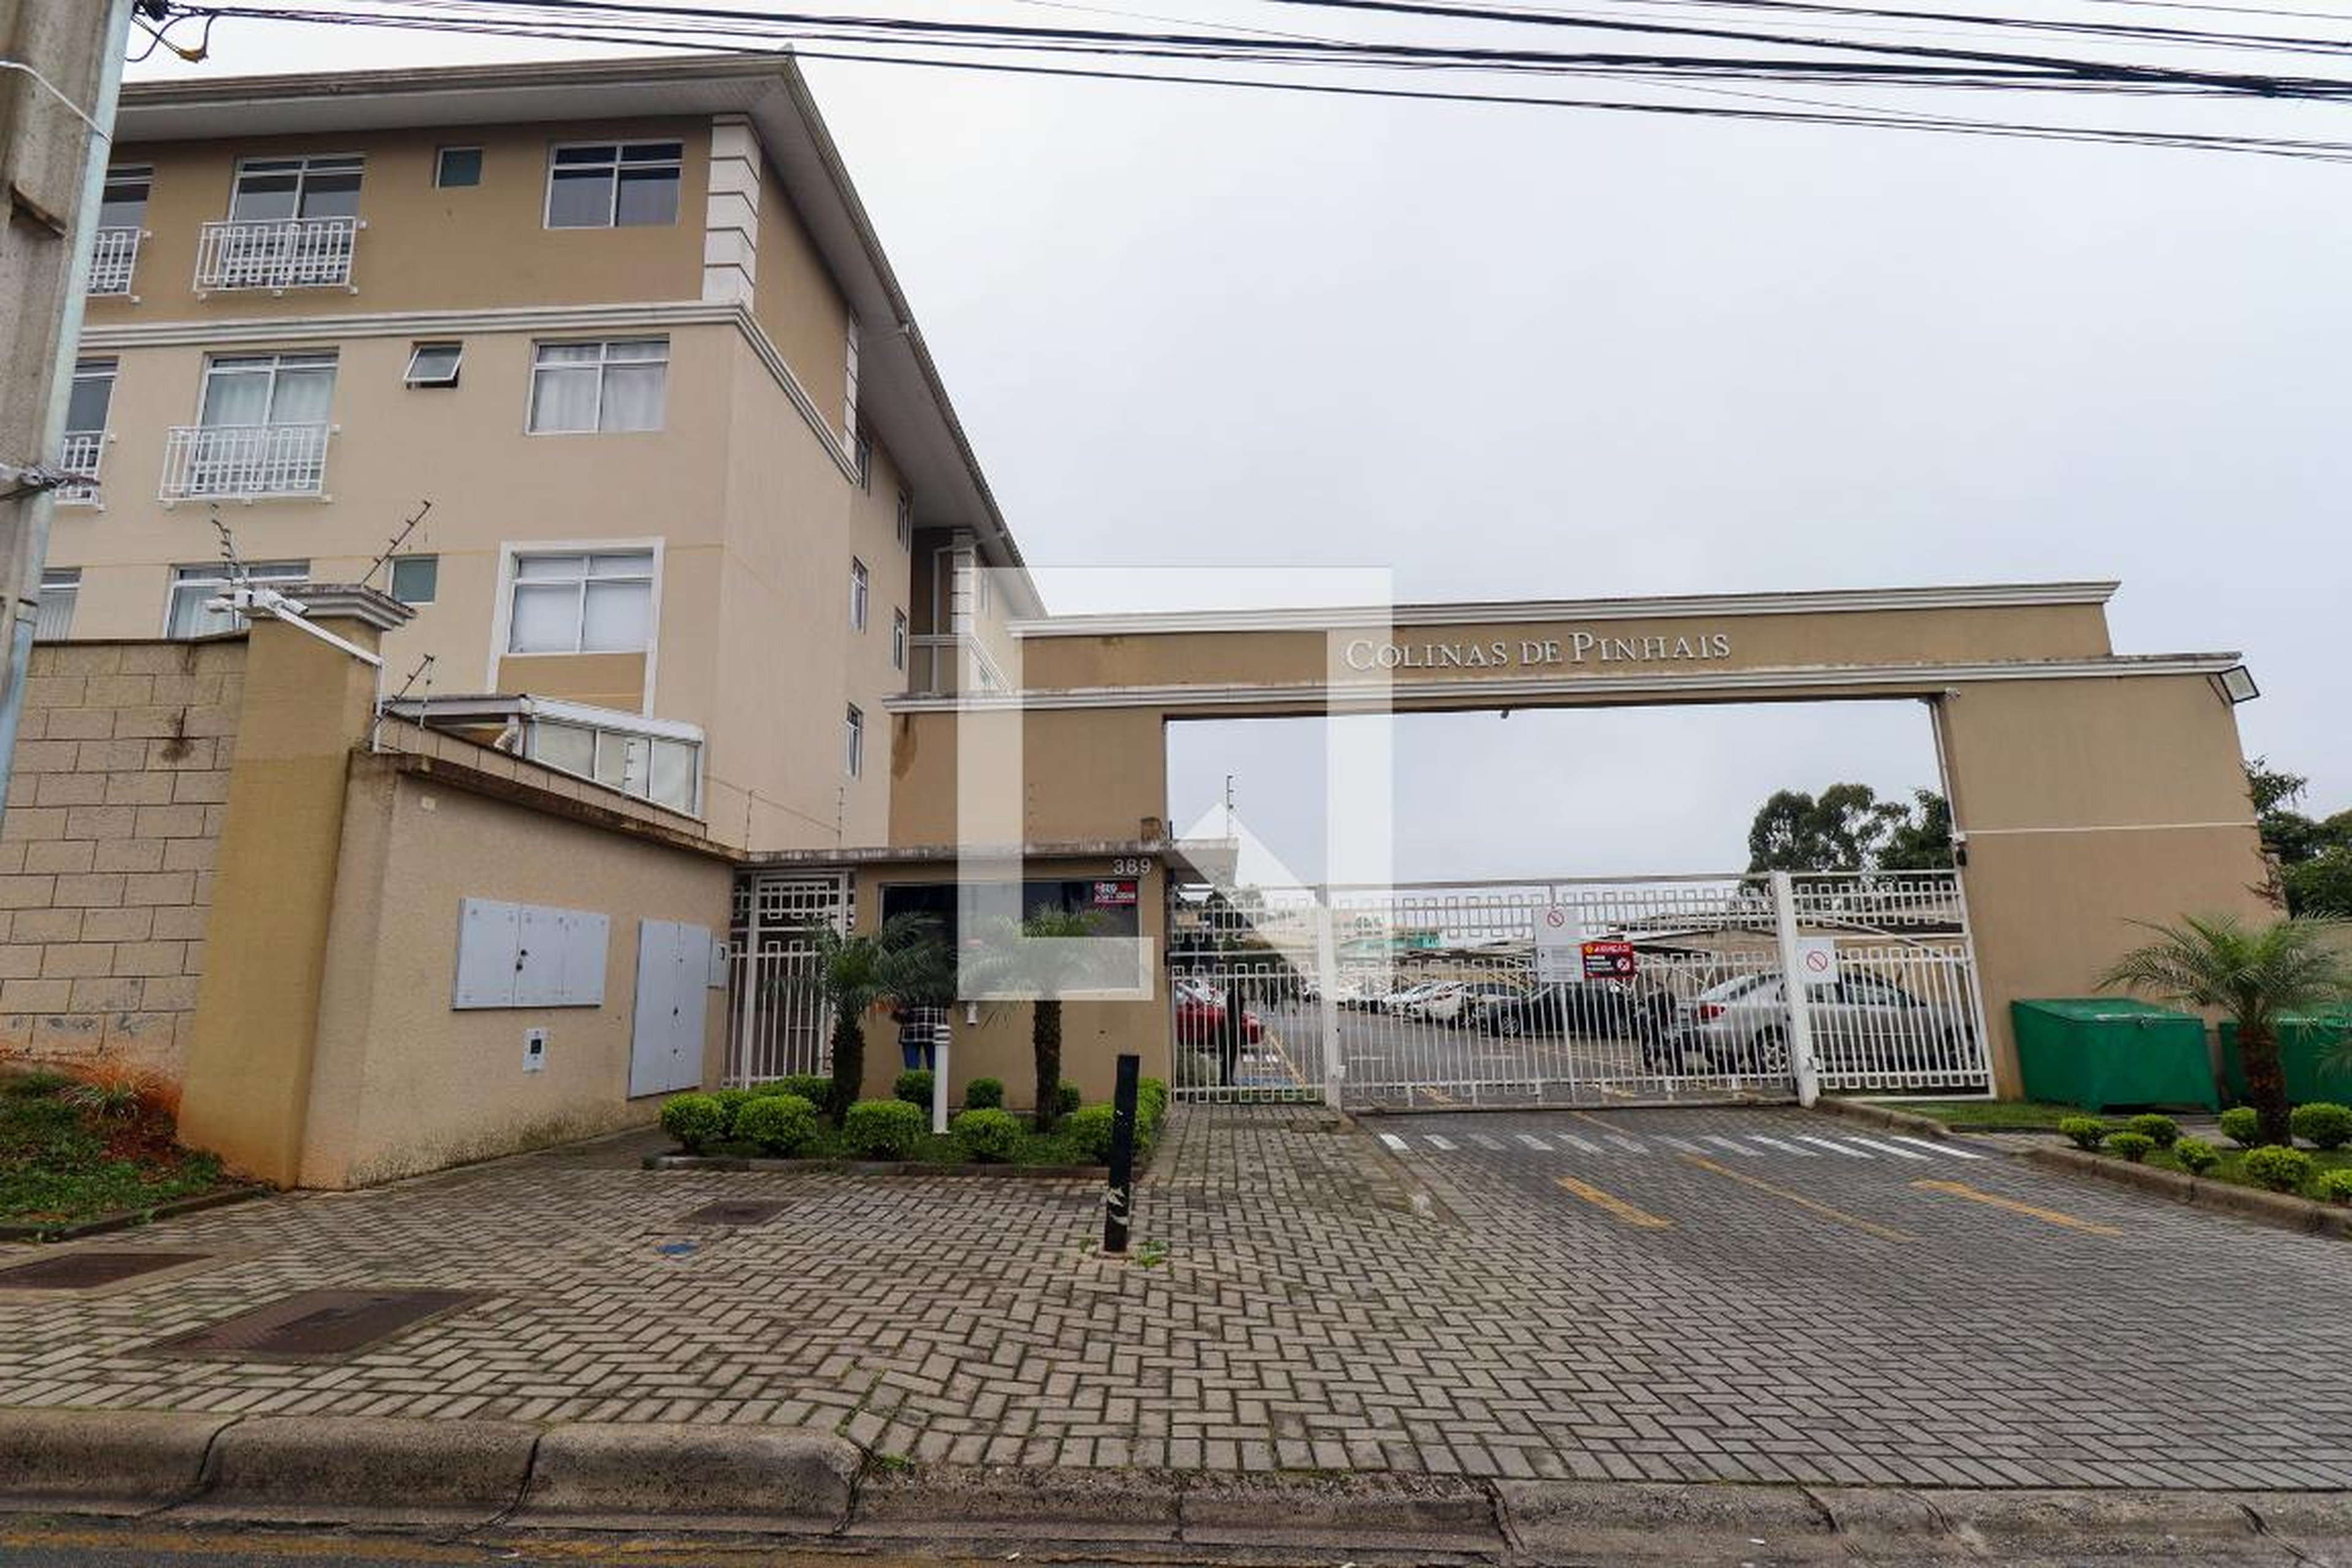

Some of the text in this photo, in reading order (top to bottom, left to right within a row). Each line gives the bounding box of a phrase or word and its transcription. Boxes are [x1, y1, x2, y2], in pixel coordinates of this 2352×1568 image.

[1346, 631, 1732, 671] COLINAS DE PINHAIS
[1113, 858, 1152, 875] 389
